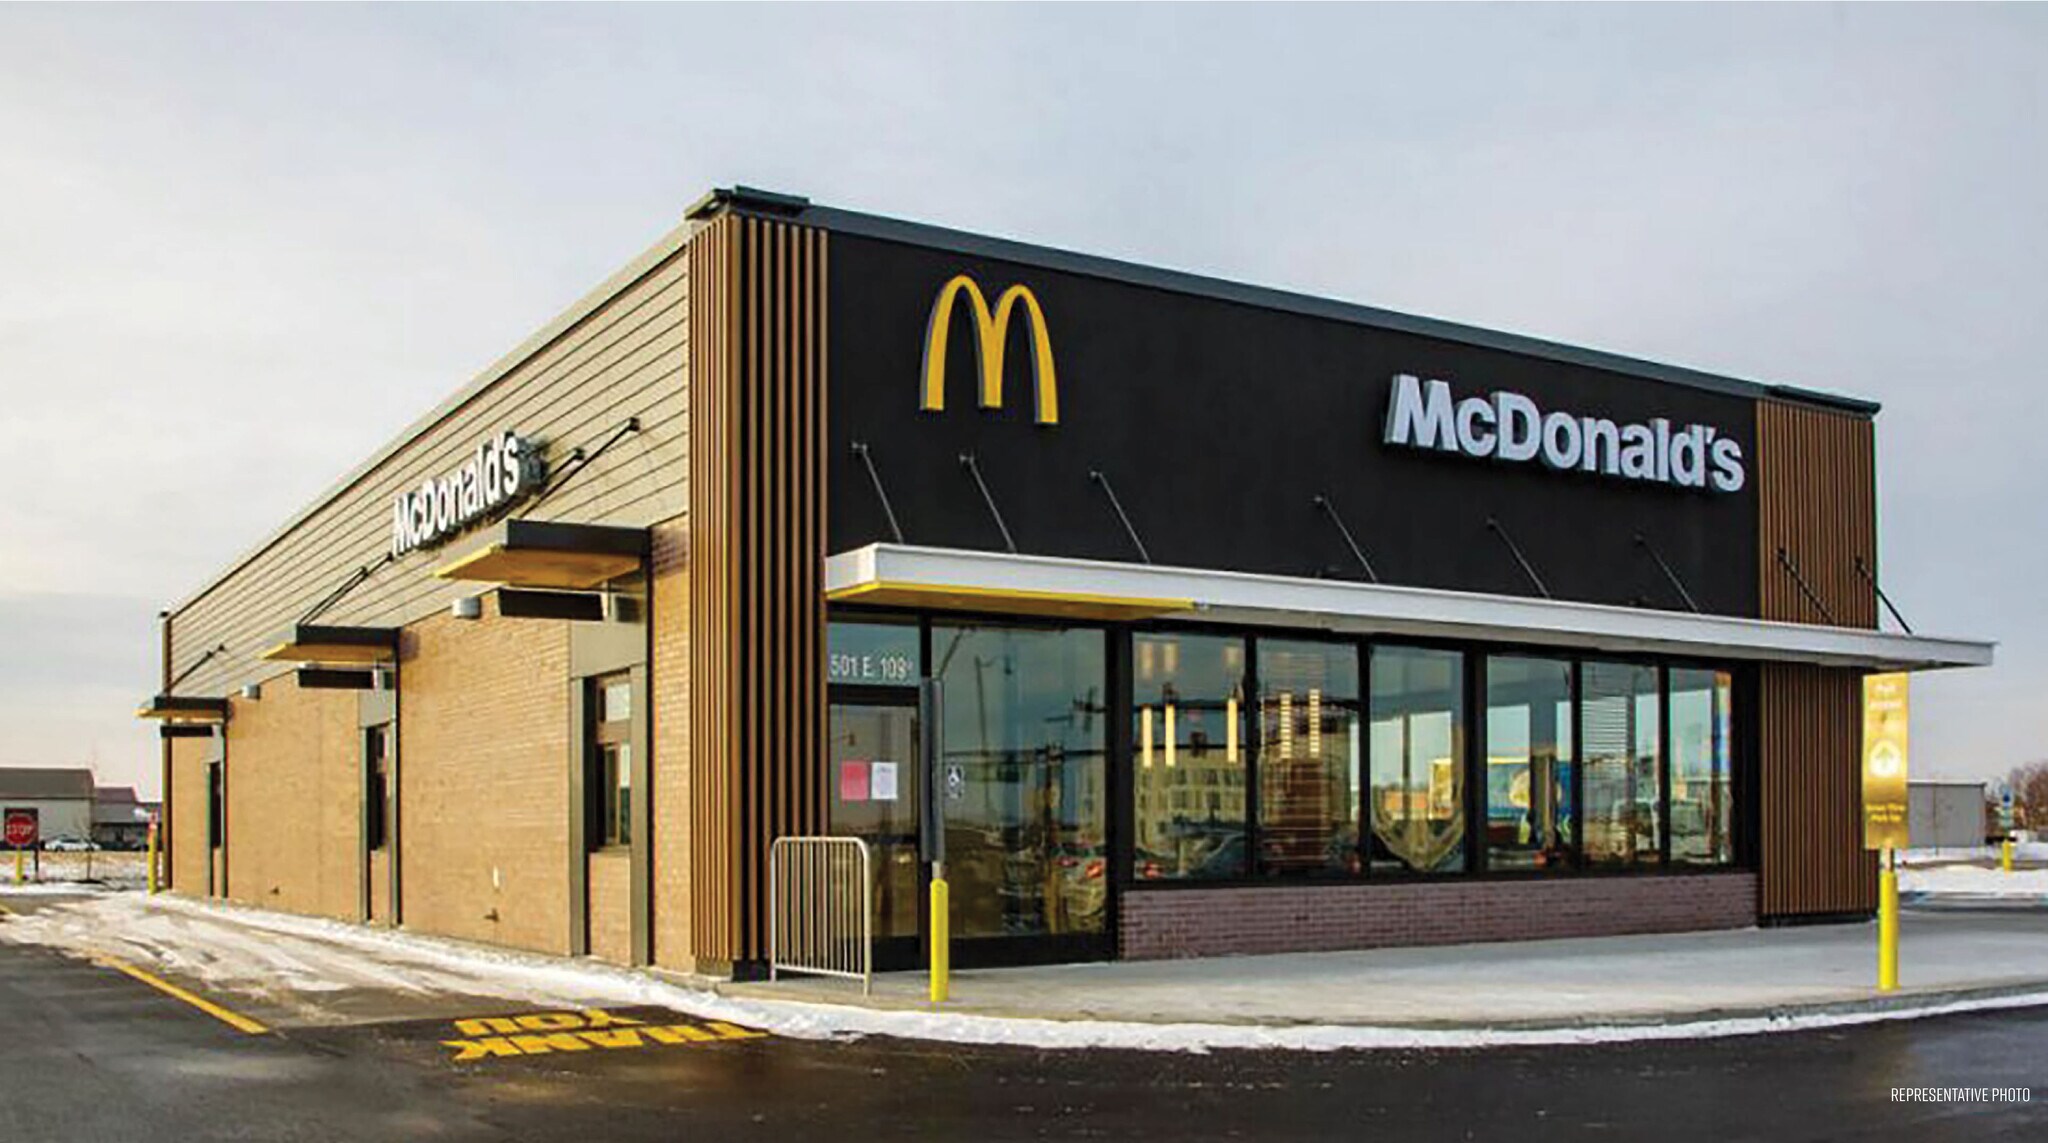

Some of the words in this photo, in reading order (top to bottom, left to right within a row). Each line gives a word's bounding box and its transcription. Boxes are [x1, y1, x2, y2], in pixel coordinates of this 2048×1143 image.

[1385, 374, 1745, 492] McDonald's
[392, 432, 520, 556] McDonald's
[829, 654, 857, 677] 501
[881, 657, 914, 680] 109
[6, 824, 33, 836] STOP
[454, 1008, 648, 1037] YOU
[438, 1021, 769, 1062] THANK
